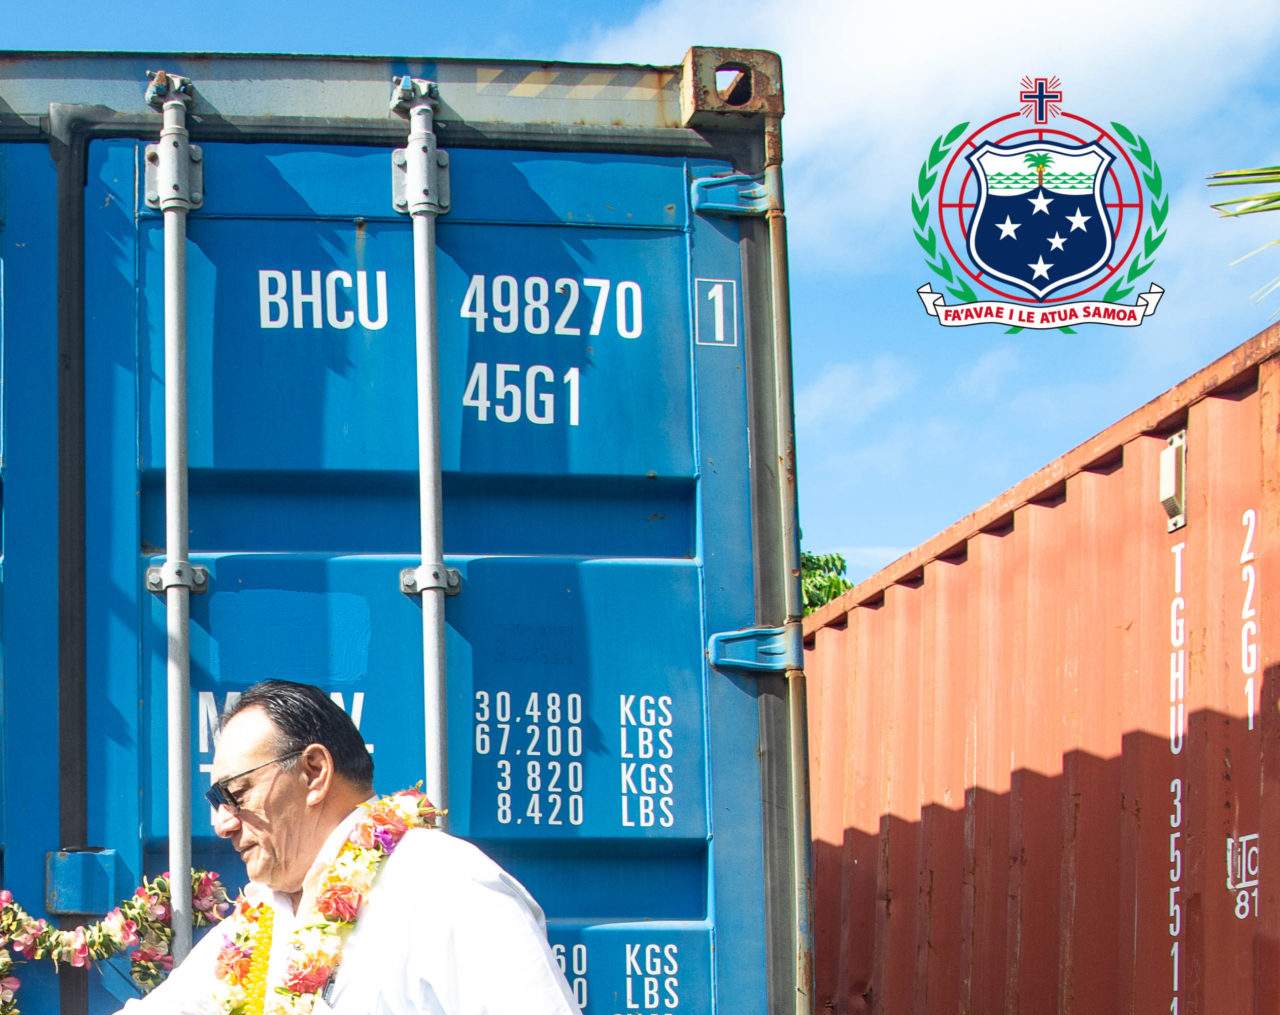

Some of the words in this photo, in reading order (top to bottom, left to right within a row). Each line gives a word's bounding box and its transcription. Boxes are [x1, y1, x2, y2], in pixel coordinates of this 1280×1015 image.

[258, 269, 388, 330] BHCU
[460, 274, 643, 339] 498270
[463, 362, 581, 427] 45G1
[1240, 508, 1257, 730] 22G1
[1170, 541, 1185, 755] TGHU
[475, 690, 582, 725] 30,480
[620, 695, 674, 726] KGS
[475, 723, 583, 756] 67,200
[620, 727, 674, 759] LBS
[621, 762, 674, 794] KGS
[497, 792, 584, 826] 8,420
[622, 795, 674, 828] LBS
[1234, 888, 1259, 919] 81
[625, 944, 679, 976] KGS
[626, 976, 680, 1009] LBS
